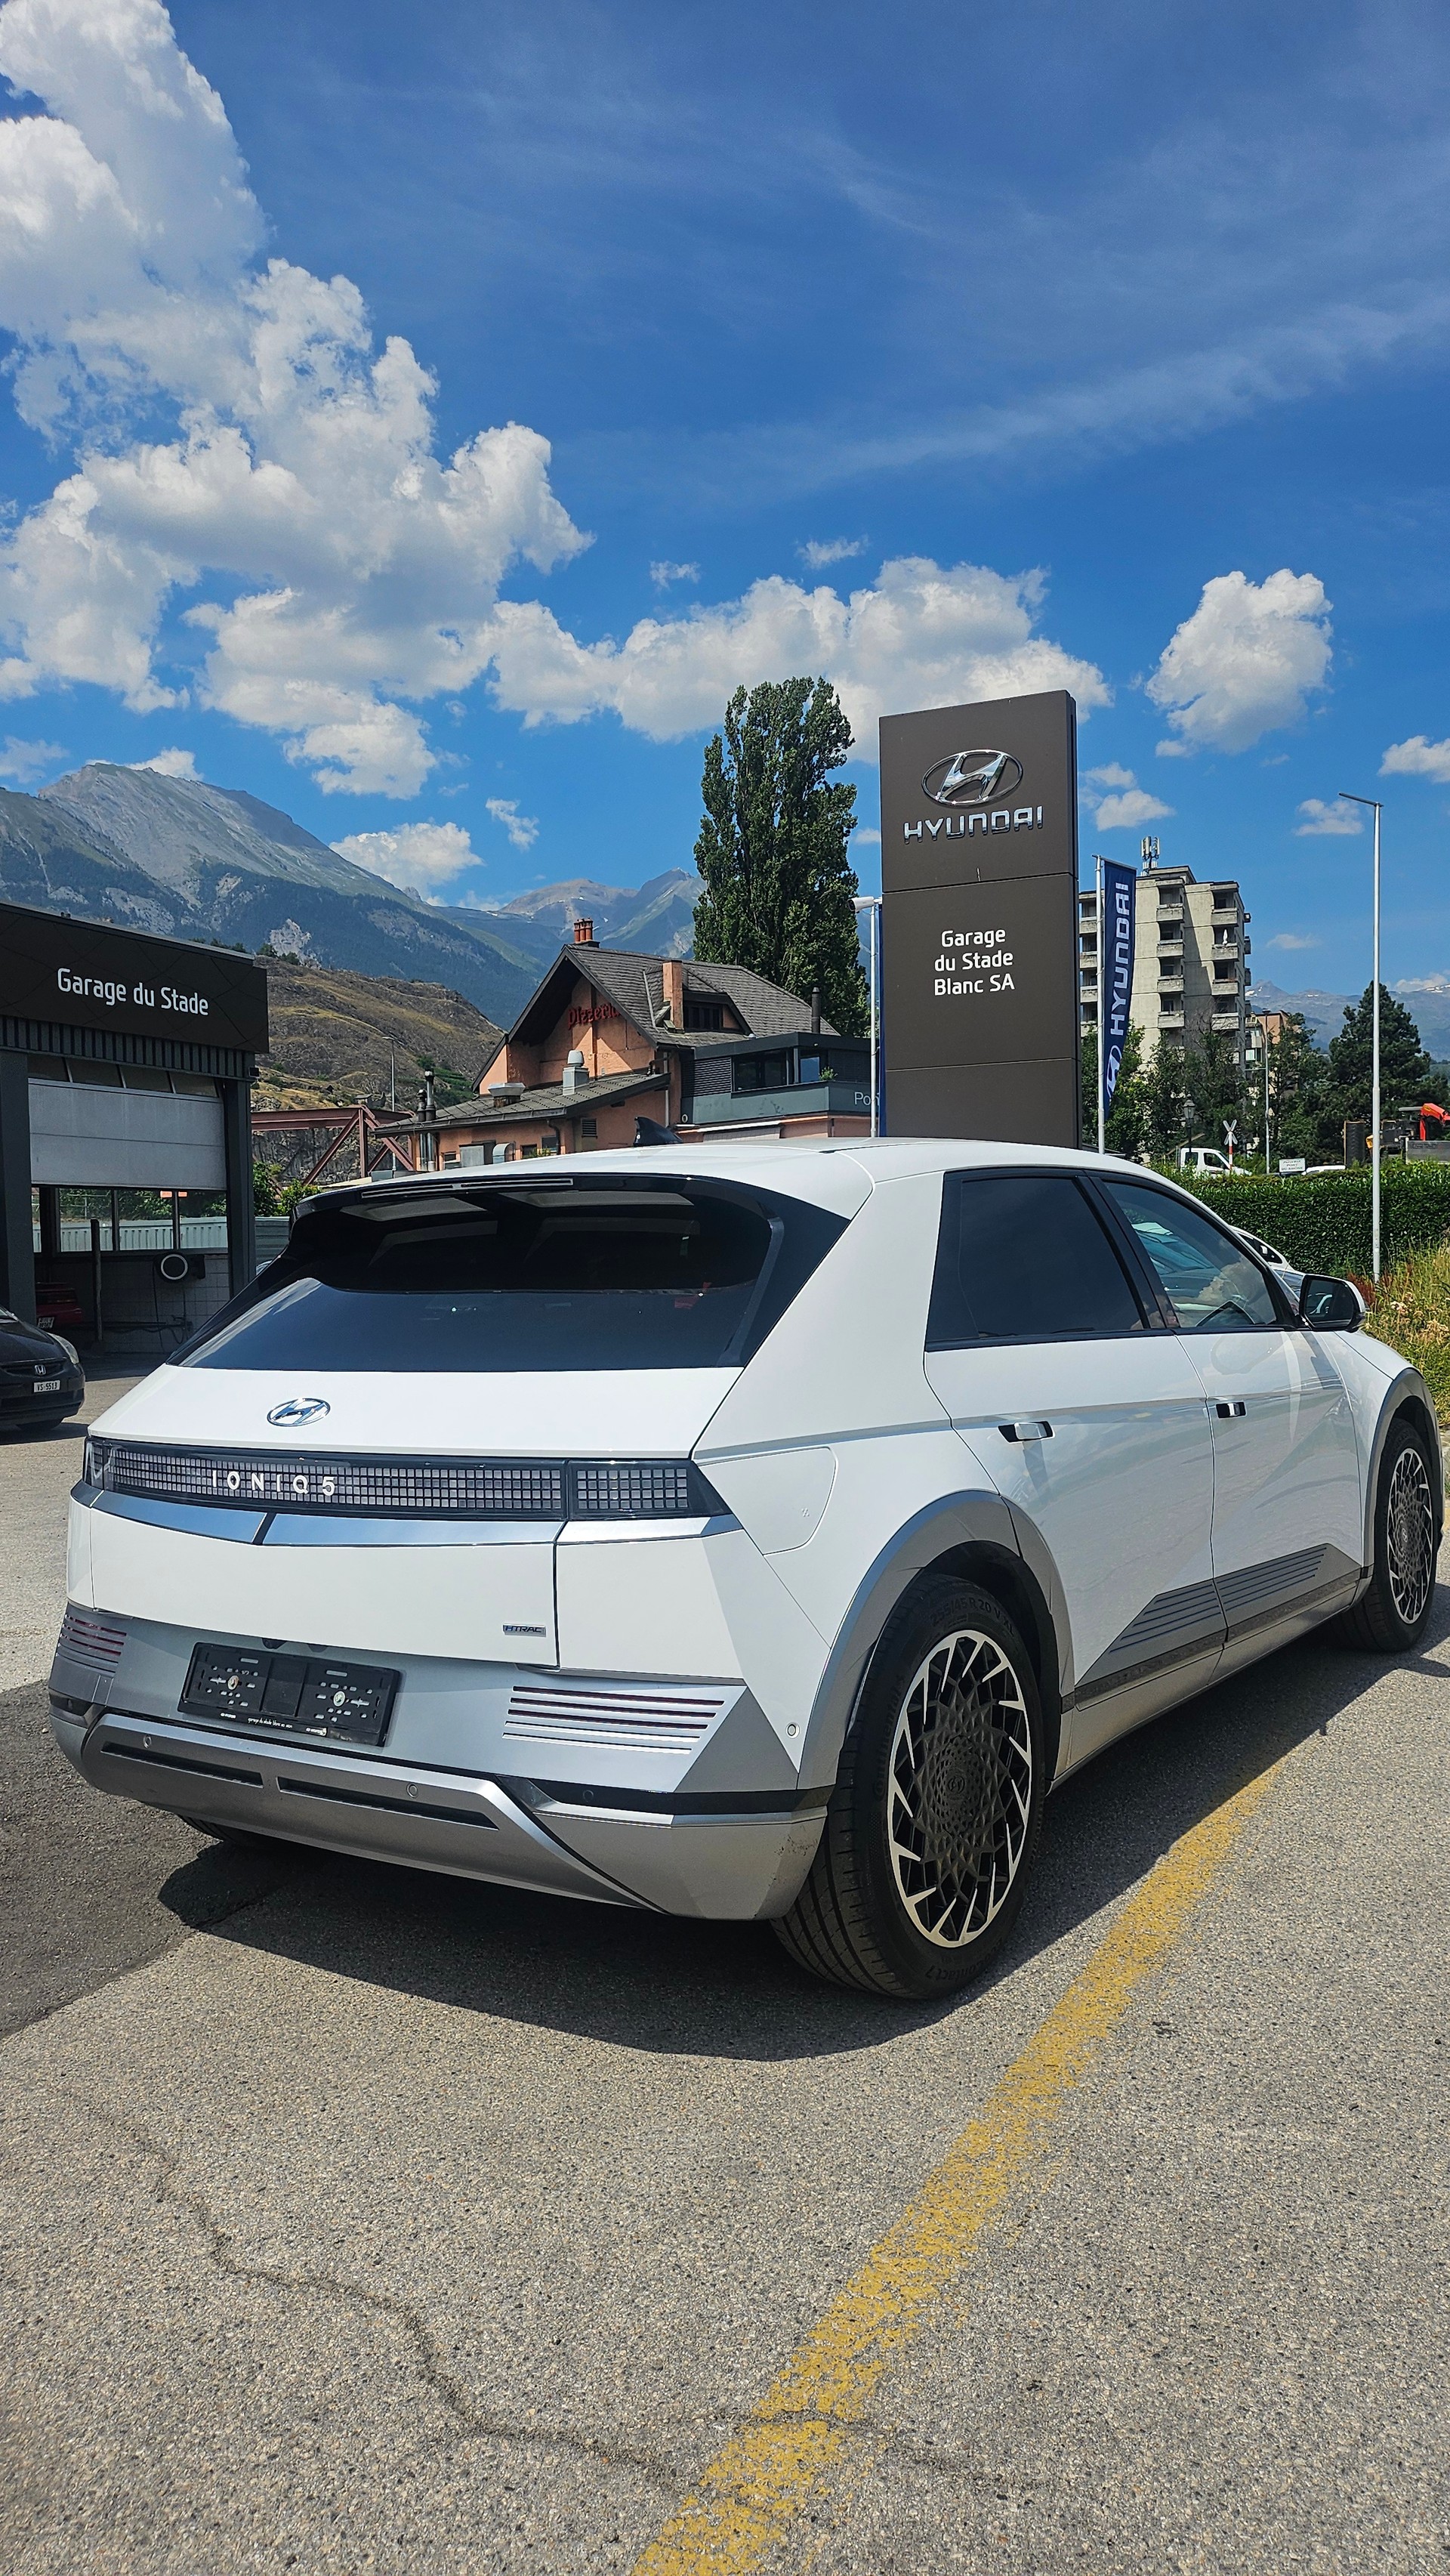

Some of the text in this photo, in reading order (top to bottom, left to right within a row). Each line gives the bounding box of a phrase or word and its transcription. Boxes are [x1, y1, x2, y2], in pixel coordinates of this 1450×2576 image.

[903, 805, 1043, 845] HYUNDAI
[941, 929, 1006, 948] Garage
[934, 950, 1013, 971] du Stade
[1110, 882, 1129, 1036] HYUNDAI
[57, 968, 208, 1015] Garage du Stade
[934, 973, 1015, 996] Blanc SA
